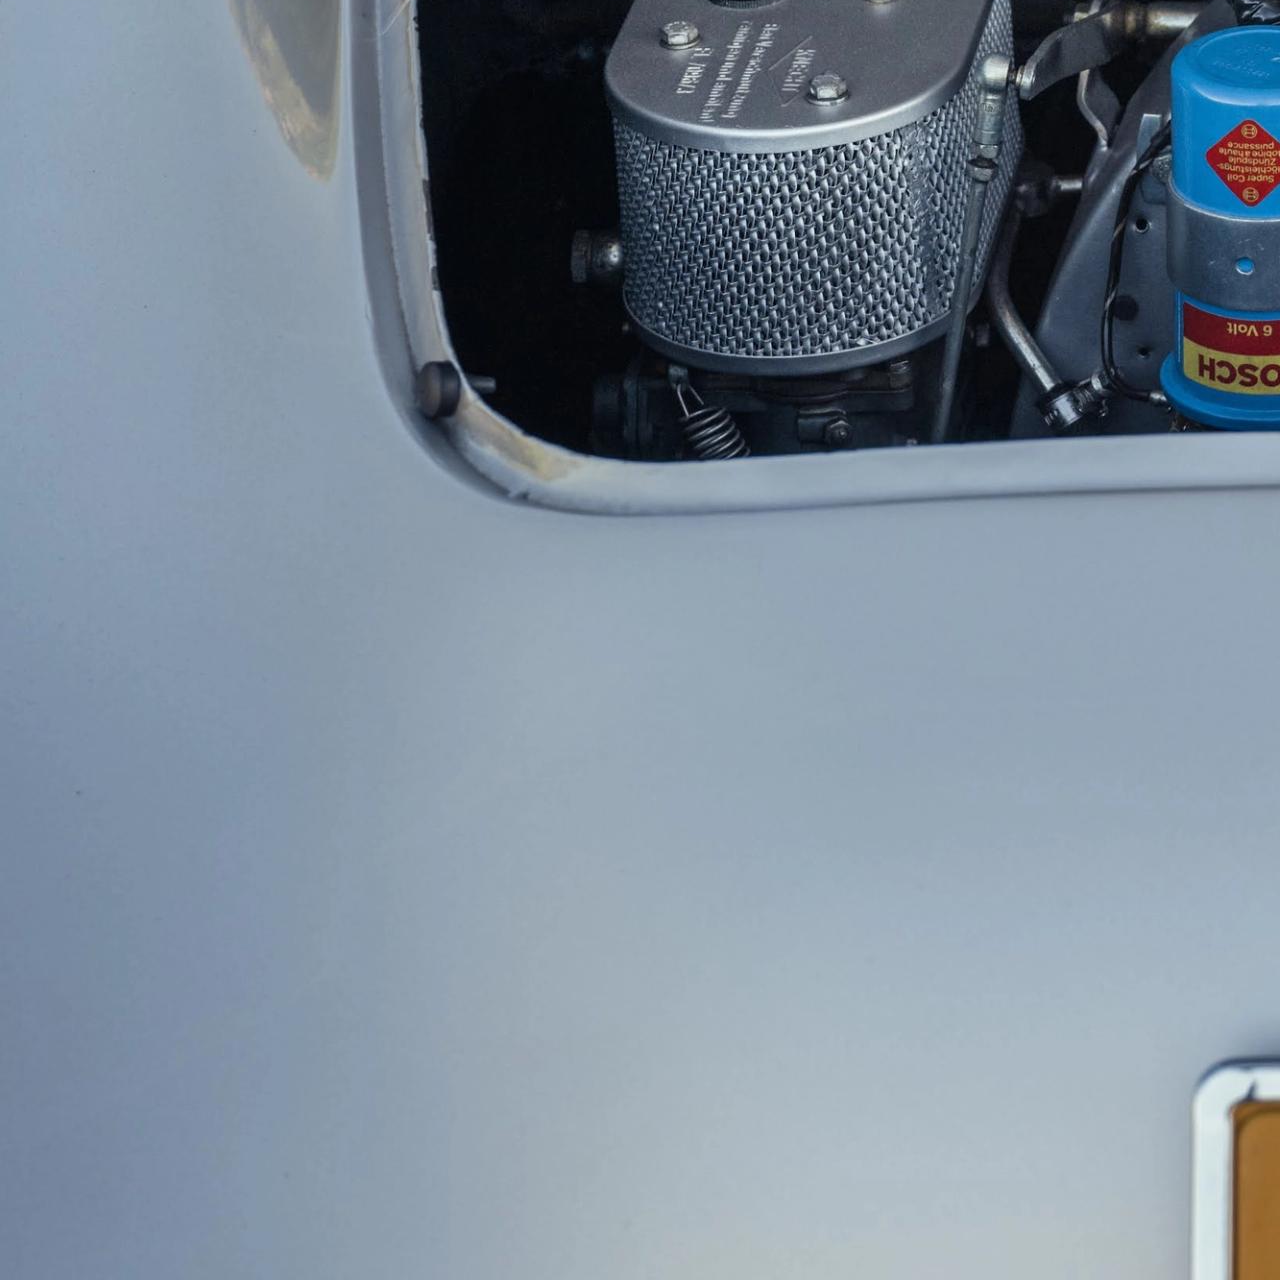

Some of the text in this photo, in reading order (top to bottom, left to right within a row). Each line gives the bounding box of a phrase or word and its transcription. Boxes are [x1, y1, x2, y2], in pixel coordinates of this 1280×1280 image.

[1227, 141, 1275, 150] puissance
[1218, 147, 1244, 157] haute
[1228, 156, 1277, 166] Zündspule
[1227, 173, 1275, 183] Super Coil
[1226, 322, 1273, 337] 6 Volt
